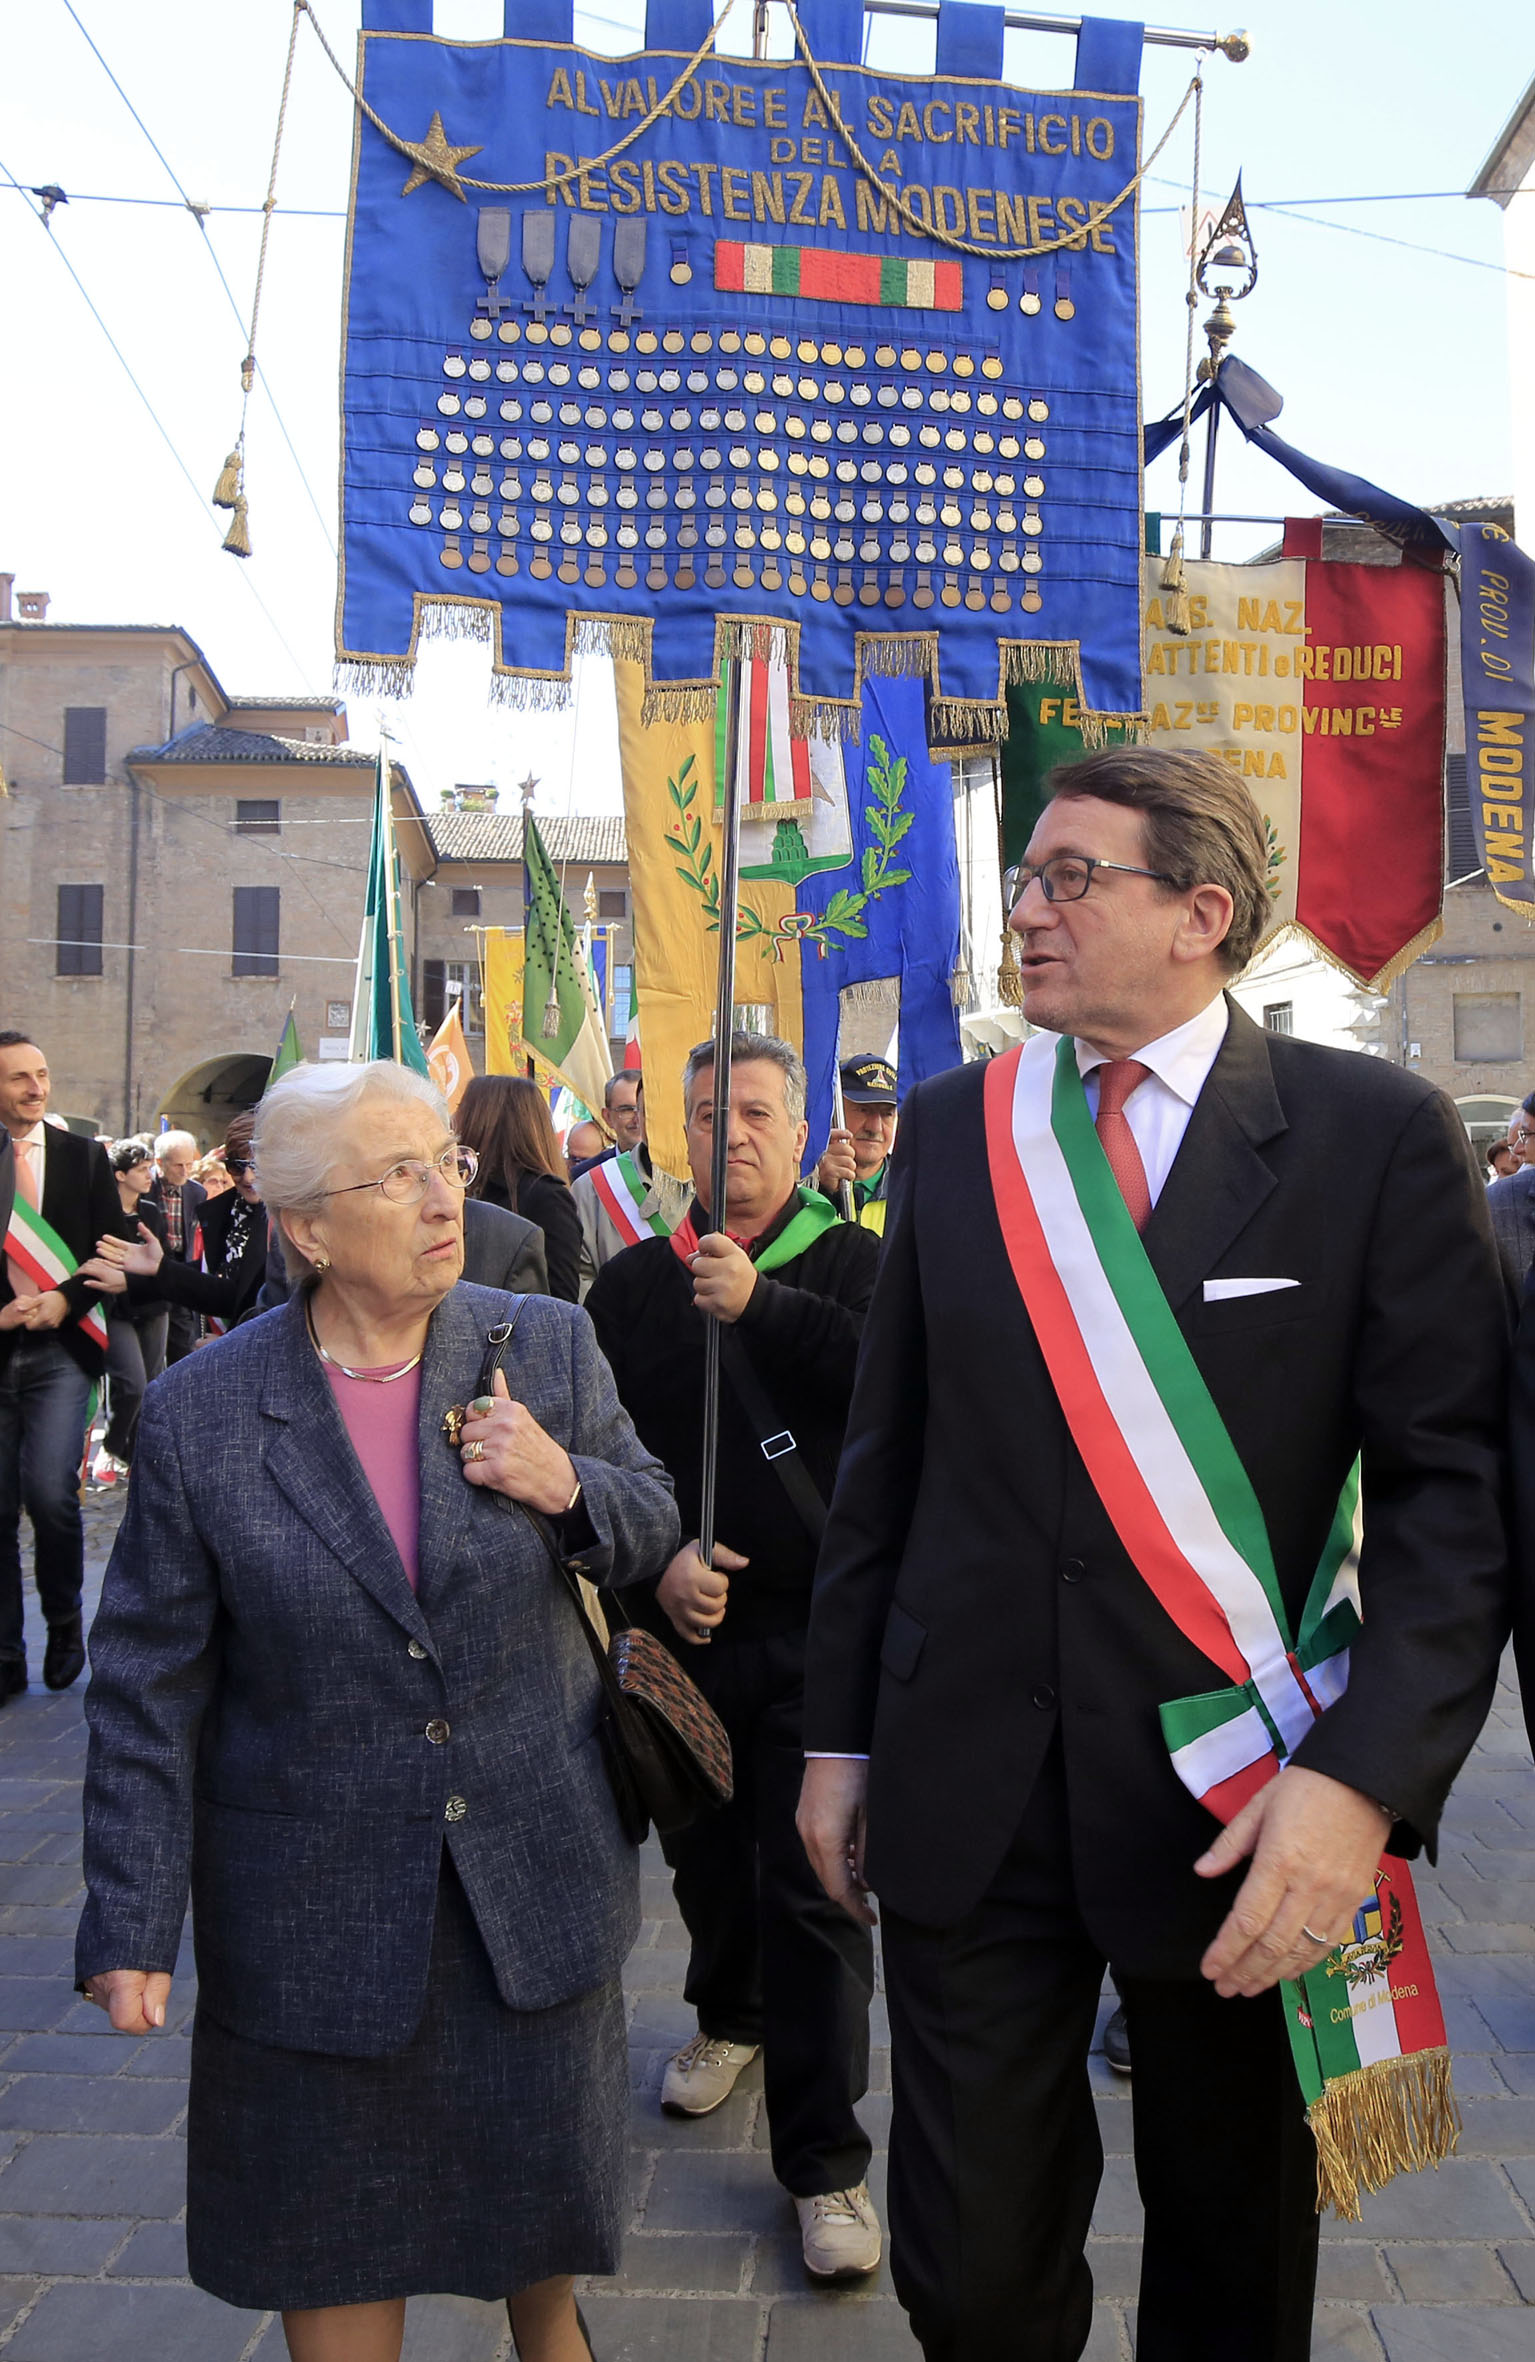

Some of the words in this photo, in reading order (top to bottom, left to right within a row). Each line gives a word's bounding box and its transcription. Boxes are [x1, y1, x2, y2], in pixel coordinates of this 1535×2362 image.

[763, 88, 788, 129] E
[802, 88, 855, 135] AL
[866, 96, 1115, 160] SACRIFICIO
[545, 152, 847, 229] RESISTENZA
[855, 179, 1116, 253] MODENESE
[1146, 595, 1214, 630] AS.
[1237, 597, 1312, 634] NAZ.
[1479, 569, 1511, 646] PROV.
[1147, 639, 1268, 677] ATTENTI
[1275, 655, 1289, 677] e
[1294, 645, 1402, 681] REDUCI
[1480, 652, 1514, 683] DI
[1476, 710, 1525, 884] MODENA
[1330, 2001, 1367, 2024] Comune
[1368, 1993, 1376, 2009] di
[1377, 1984, 1419, 2005] Modena
